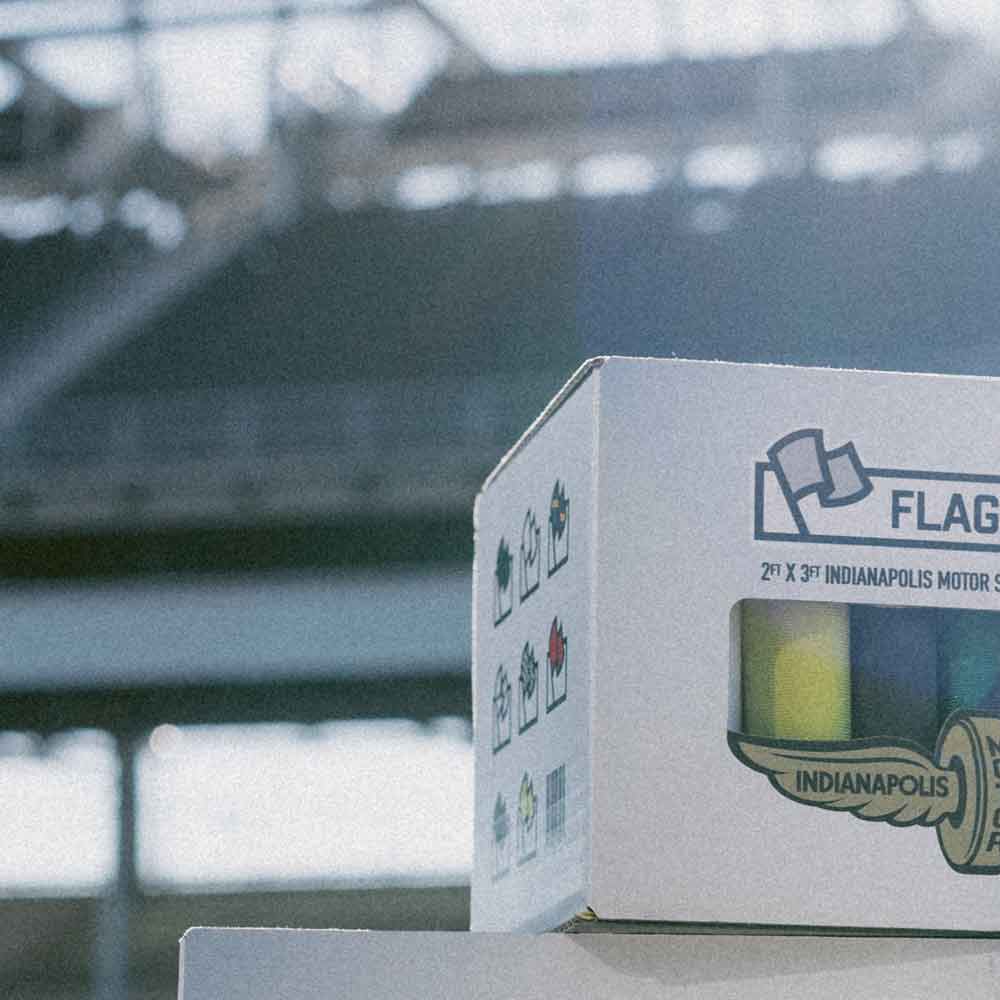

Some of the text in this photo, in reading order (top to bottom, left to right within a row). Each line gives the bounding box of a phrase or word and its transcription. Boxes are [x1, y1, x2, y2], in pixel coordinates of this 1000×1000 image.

[761, 562, 781, 581] 2FT
[786, 563, 795, 582] X
[800, 564, 821, 583] 3FT
[825, 565, 932, 589] INDIANAPOLIS
[938, 571, 989, 592] MOTOR
[796, 770, 949, 798] INDIANAPOLIS
